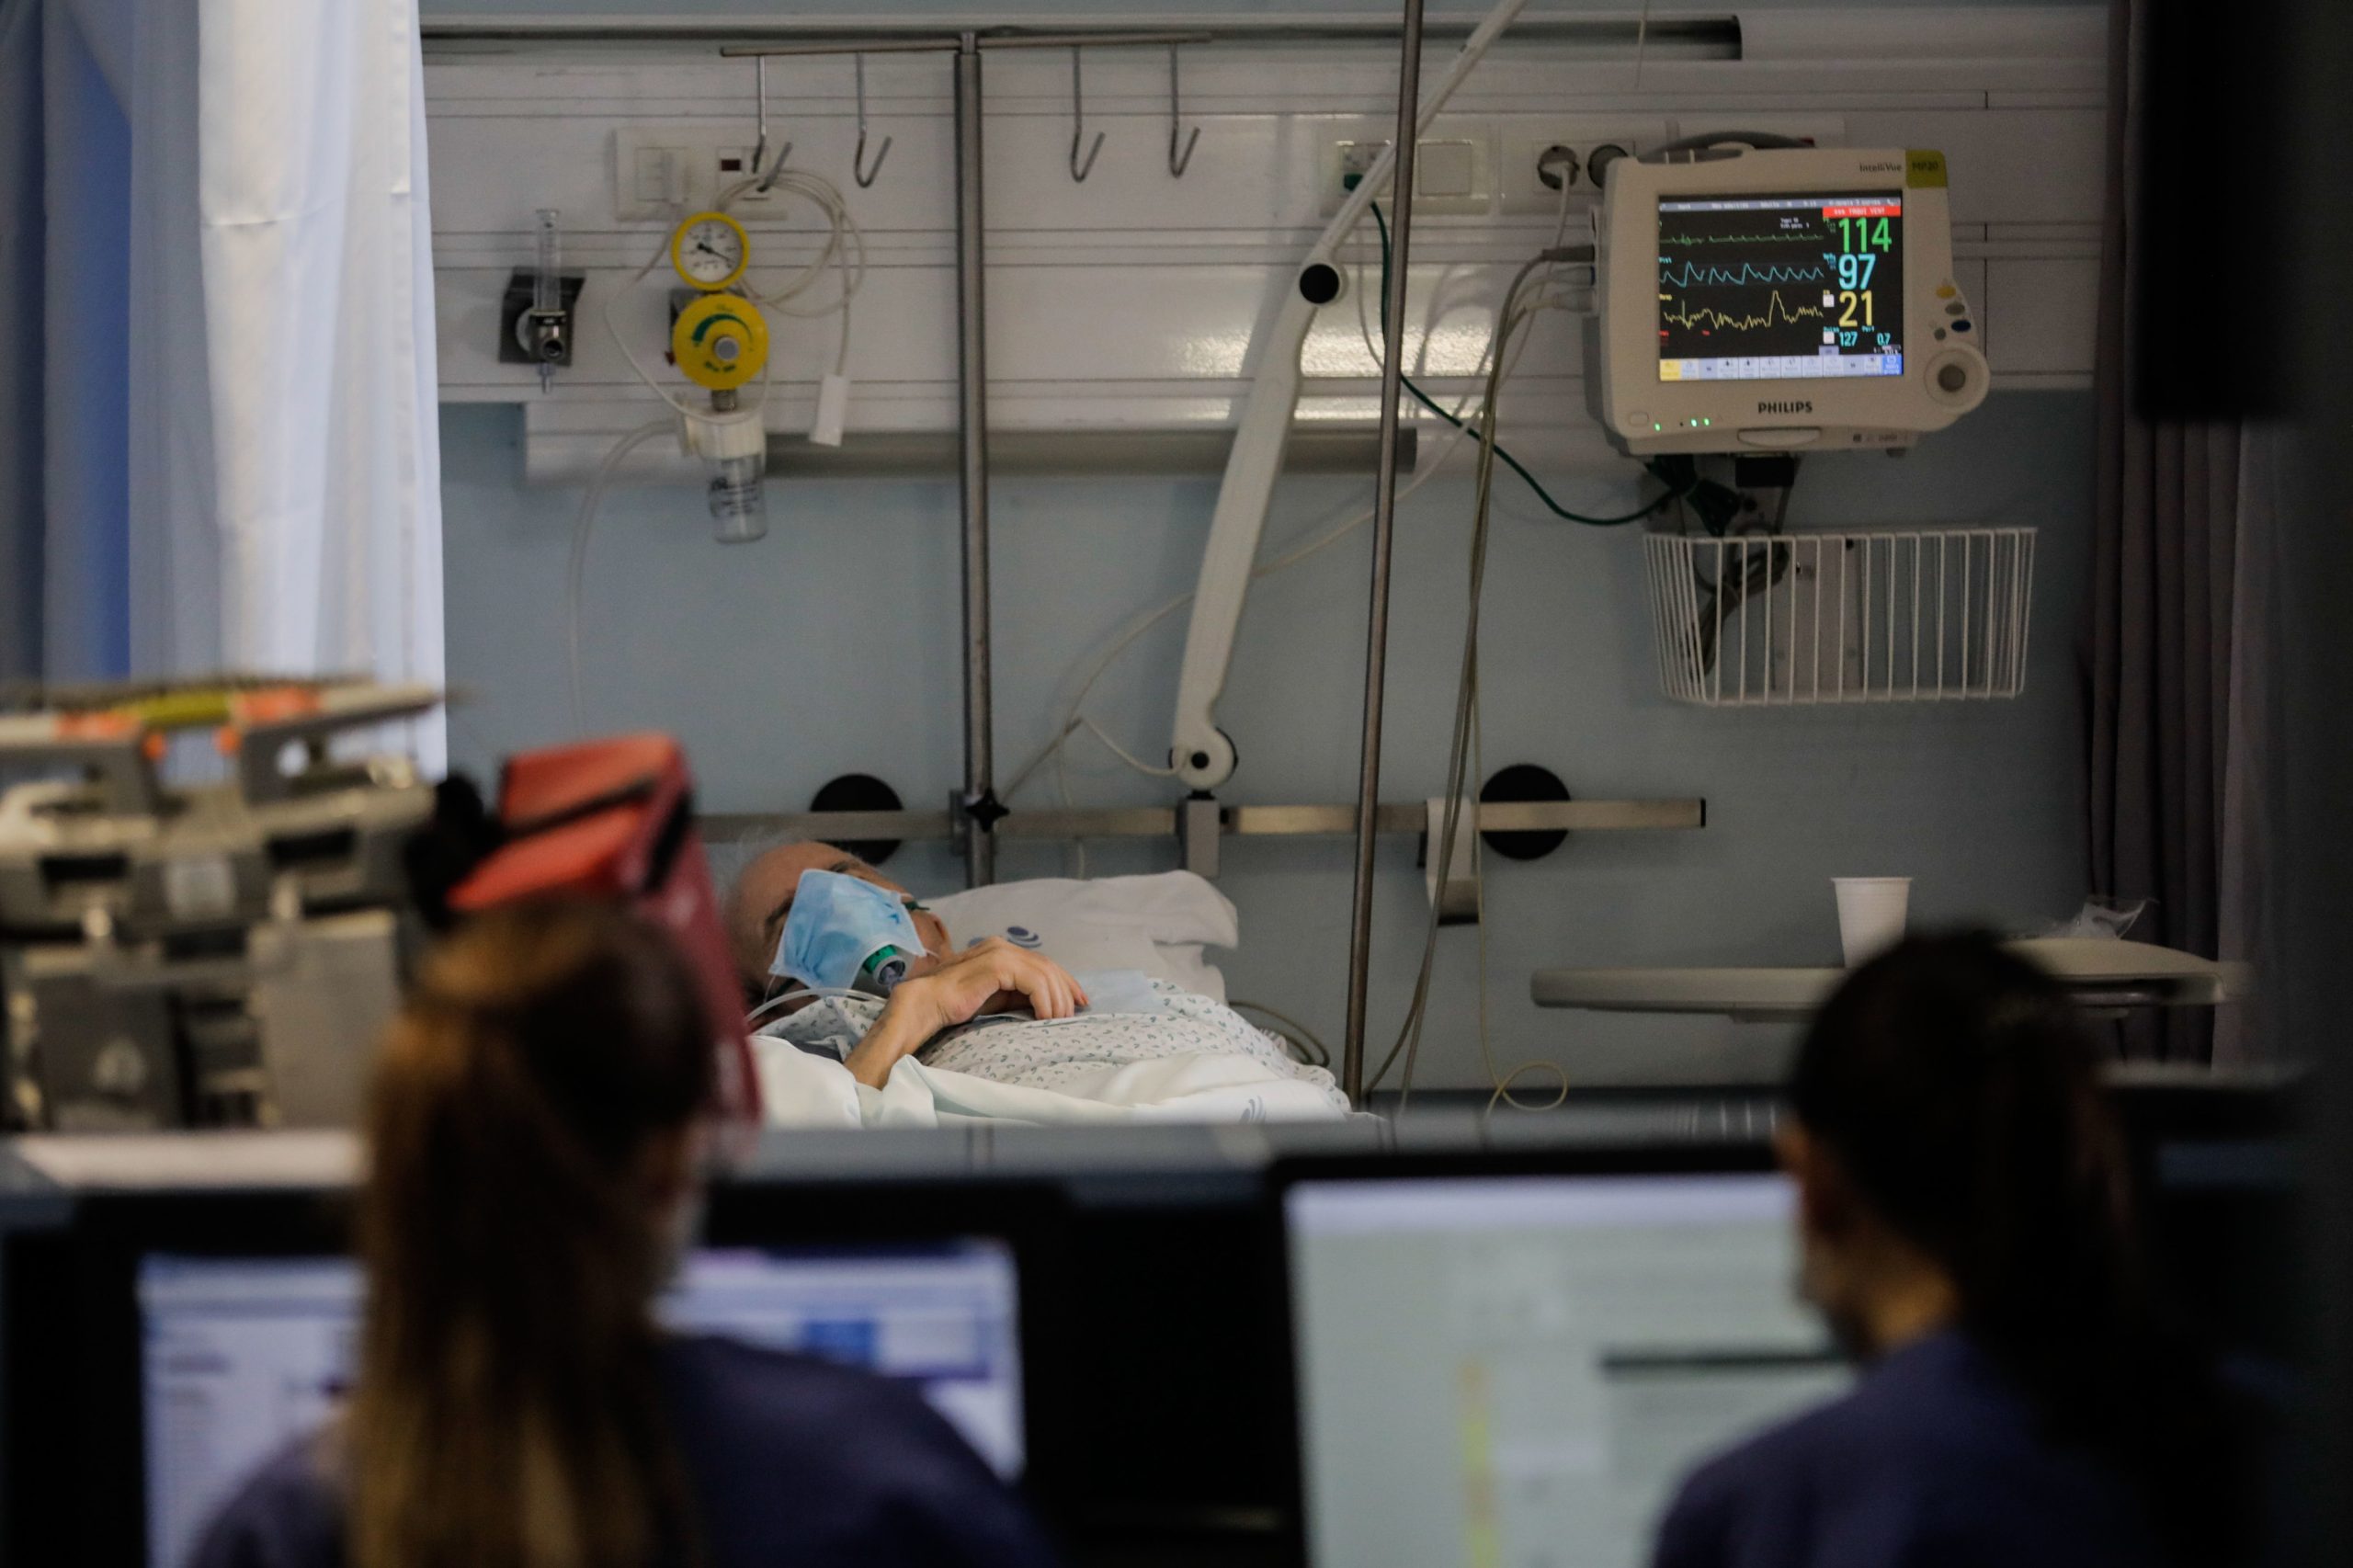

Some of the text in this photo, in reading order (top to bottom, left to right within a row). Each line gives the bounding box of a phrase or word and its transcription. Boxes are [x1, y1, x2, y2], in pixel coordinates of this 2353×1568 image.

[1859, 162, 1902, 173] IntelliVue
[1838, 217, 1892, 253] 114
[1838, 253, 1876, 290] 97
[1838, 290, 1873, 326] 21
[1839, 332, 1858, 347] 127
[1757, 401, 1813, 414] PHILIPS
